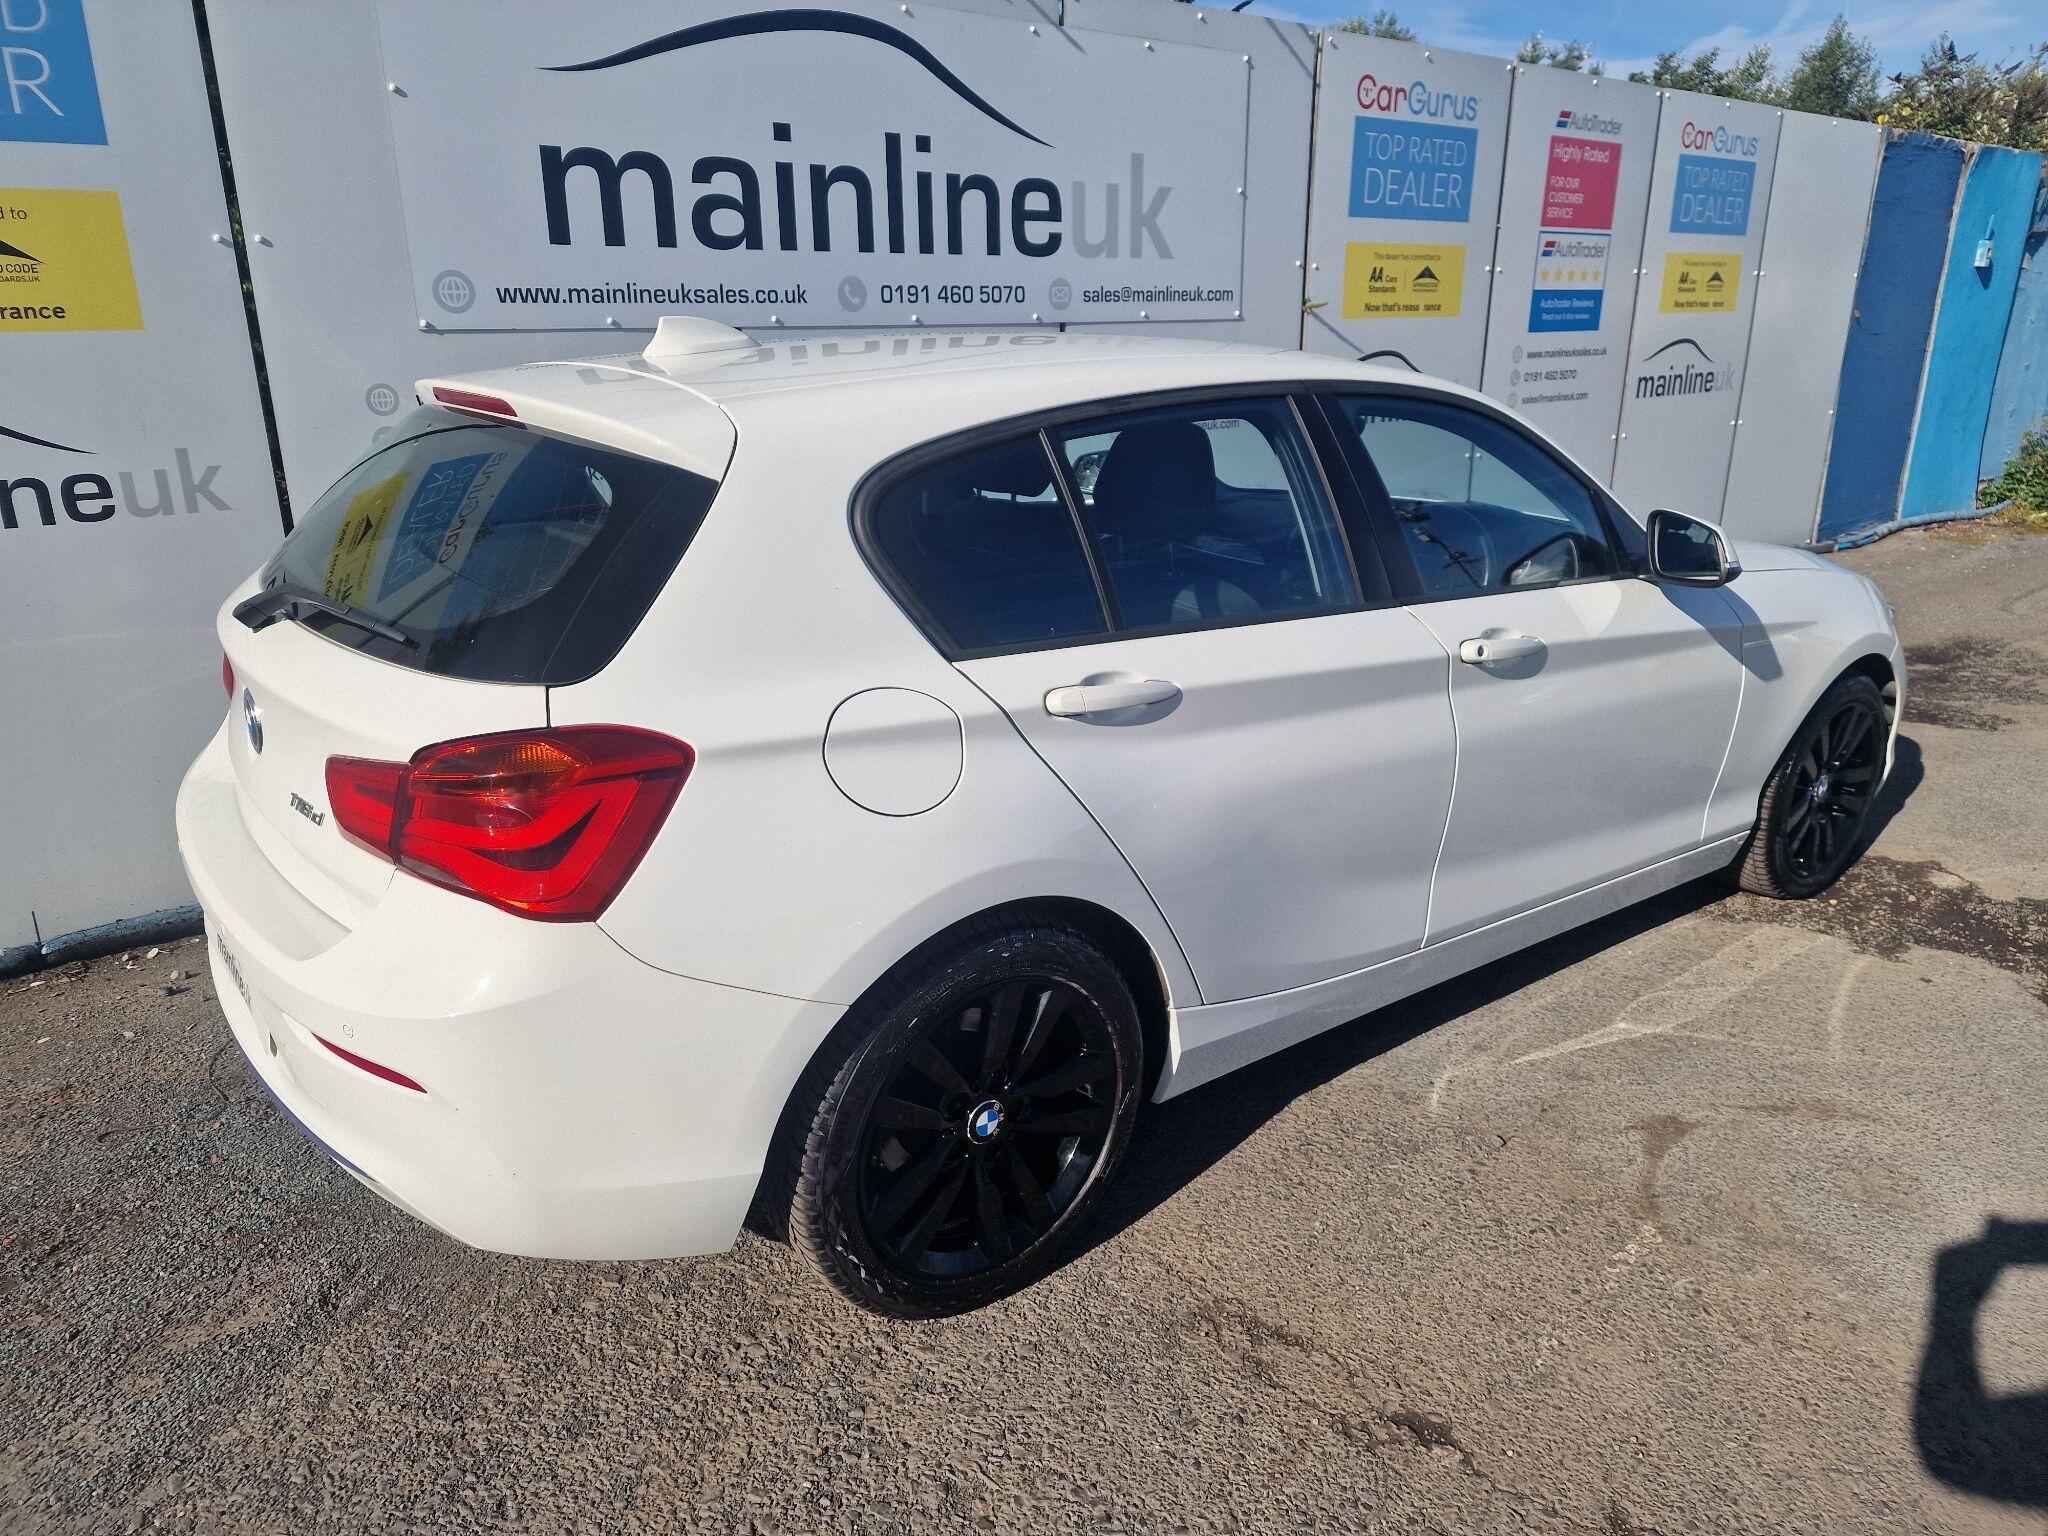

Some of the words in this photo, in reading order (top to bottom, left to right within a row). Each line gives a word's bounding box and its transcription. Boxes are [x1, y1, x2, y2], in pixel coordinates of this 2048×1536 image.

[1357, 74, 1478, 121] CarGurus
[1682, 121, 1757, 156] CarGurus
[1365, 132, 1404, 160] TOP
[1409, 136, 1467, 166] RATED
[1554, 143, 1581, 162] Highly
[1583, 146, 1610, 163] Rated
[1364, 168, 1462, 208] DEALER
[1551, 176, 1564, 187] FOR
[1684, 166, 1709, 188] TOP
[1710, 168, 1748, 192] RATED
[1549, 191, 1584, 204] CUSTOMER
[10, 206, 28, 220] to
[1547, 206, 1574, 219] SERVICE
[1680, 194, 1744, 224] DEALER
[6, 263, 39, 274] CODE
[496, 282, 808, 304] www.mainlineuksales.co.uk
[880, 285, 930, 304] 0191
[937, 285, 974, 303] 460
[979, 285, 1025, 303] 5070
[1083, 285, 1234, 303] sales@mainlineuk.com
